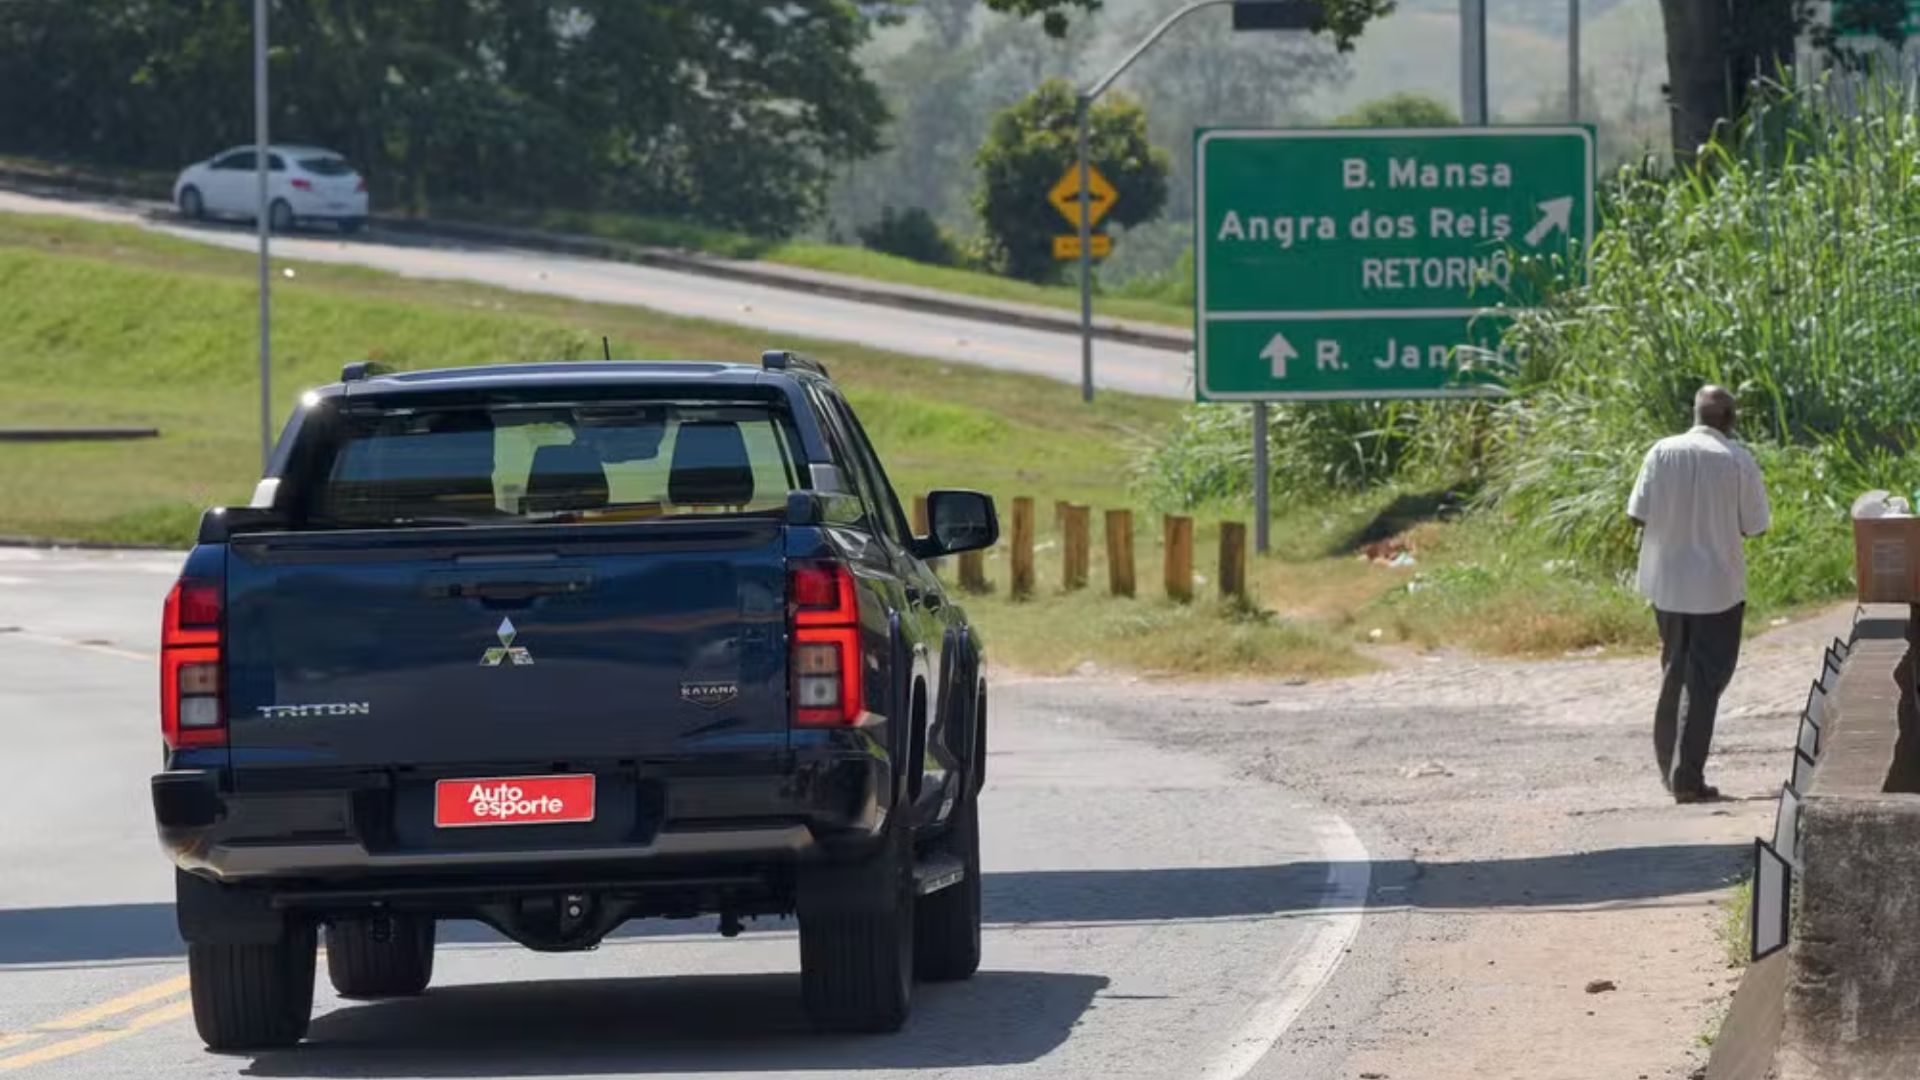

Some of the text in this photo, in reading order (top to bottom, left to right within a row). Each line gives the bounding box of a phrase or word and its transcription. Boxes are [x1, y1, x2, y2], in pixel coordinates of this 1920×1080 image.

[1343, 158, 1511, 188] B. Mansa
[1218, 208, 1511, 248] Angra dos Reis
[1362, 256, 1511, 288] RETORNO
[1316, 339, 1349, 370] R.
[257, 701, 369, 718] TRITON
[467, 783, 523, 803] Auto
[473, 795, 564, 819] esporte
